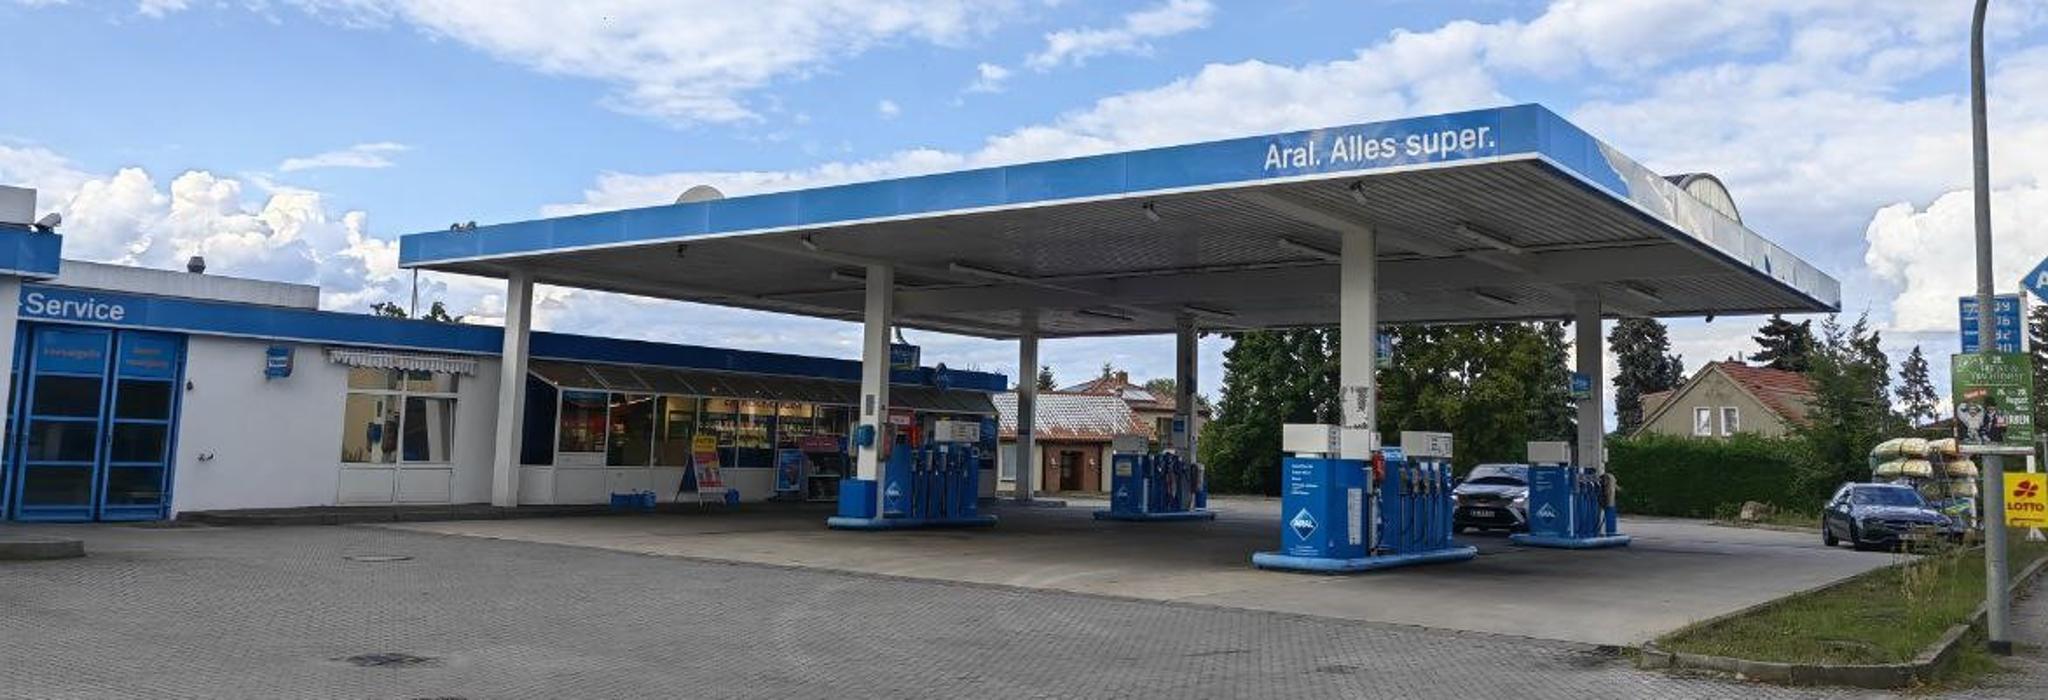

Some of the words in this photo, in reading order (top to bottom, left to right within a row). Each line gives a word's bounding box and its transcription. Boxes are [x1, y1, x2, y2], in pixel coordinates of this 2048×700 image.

[1264, 141, 1320, 170] Aral.
[1331, 134, 1396, 163] Alles
[1405, 126, 1495, 158] super.
[2007, 502, 2045, 512] LOTTO
